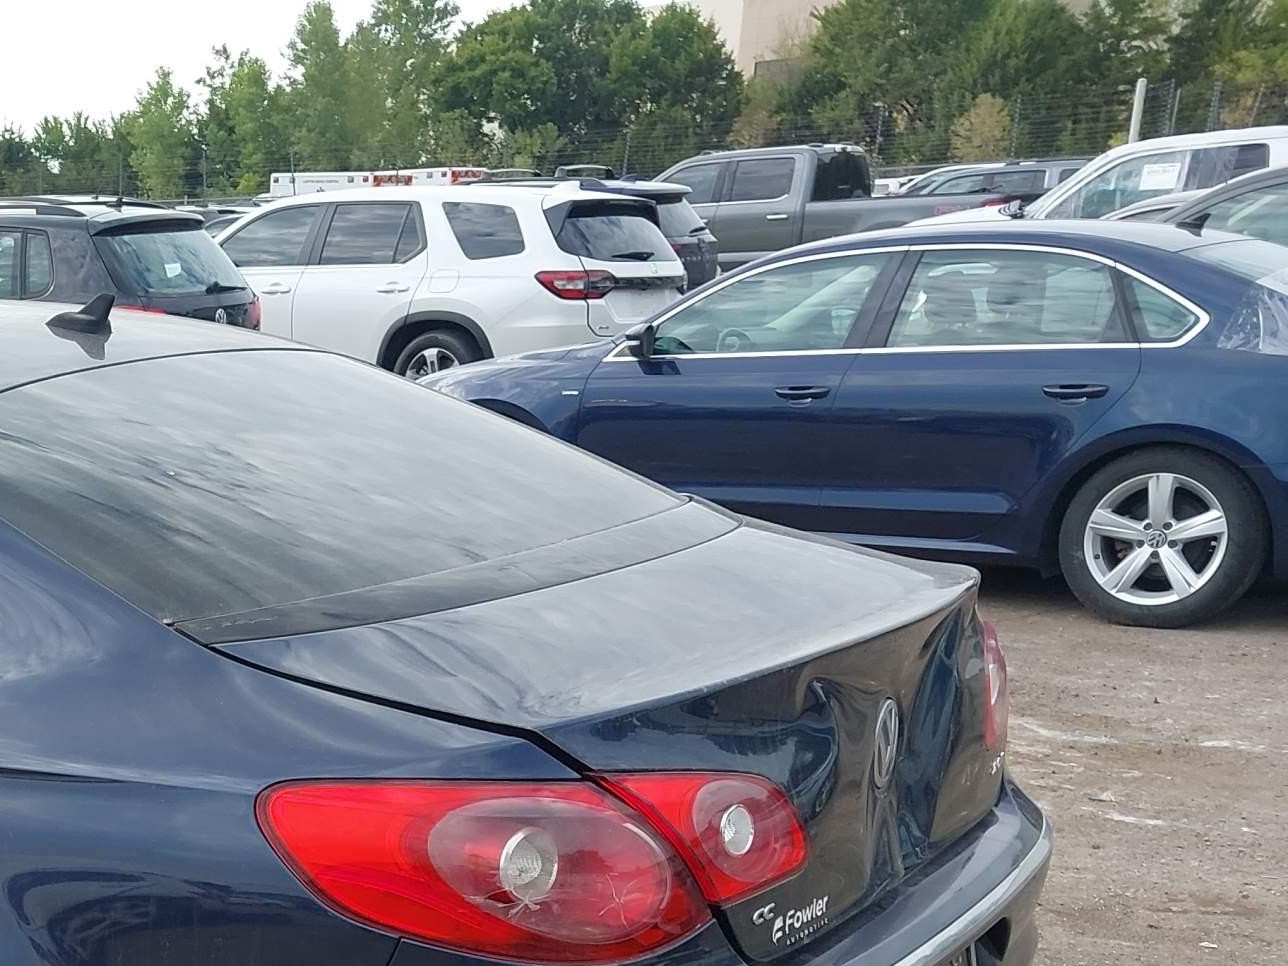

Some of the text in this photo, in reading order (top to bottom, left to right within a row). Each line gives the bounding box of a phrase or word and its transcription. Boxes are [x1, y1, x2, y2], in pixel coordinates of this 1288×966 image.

[752, 902, 776, 925] CC
[785, 895, 829, 934] Fowler
[786, 917, 829, 945] AUTOMOTIVE
